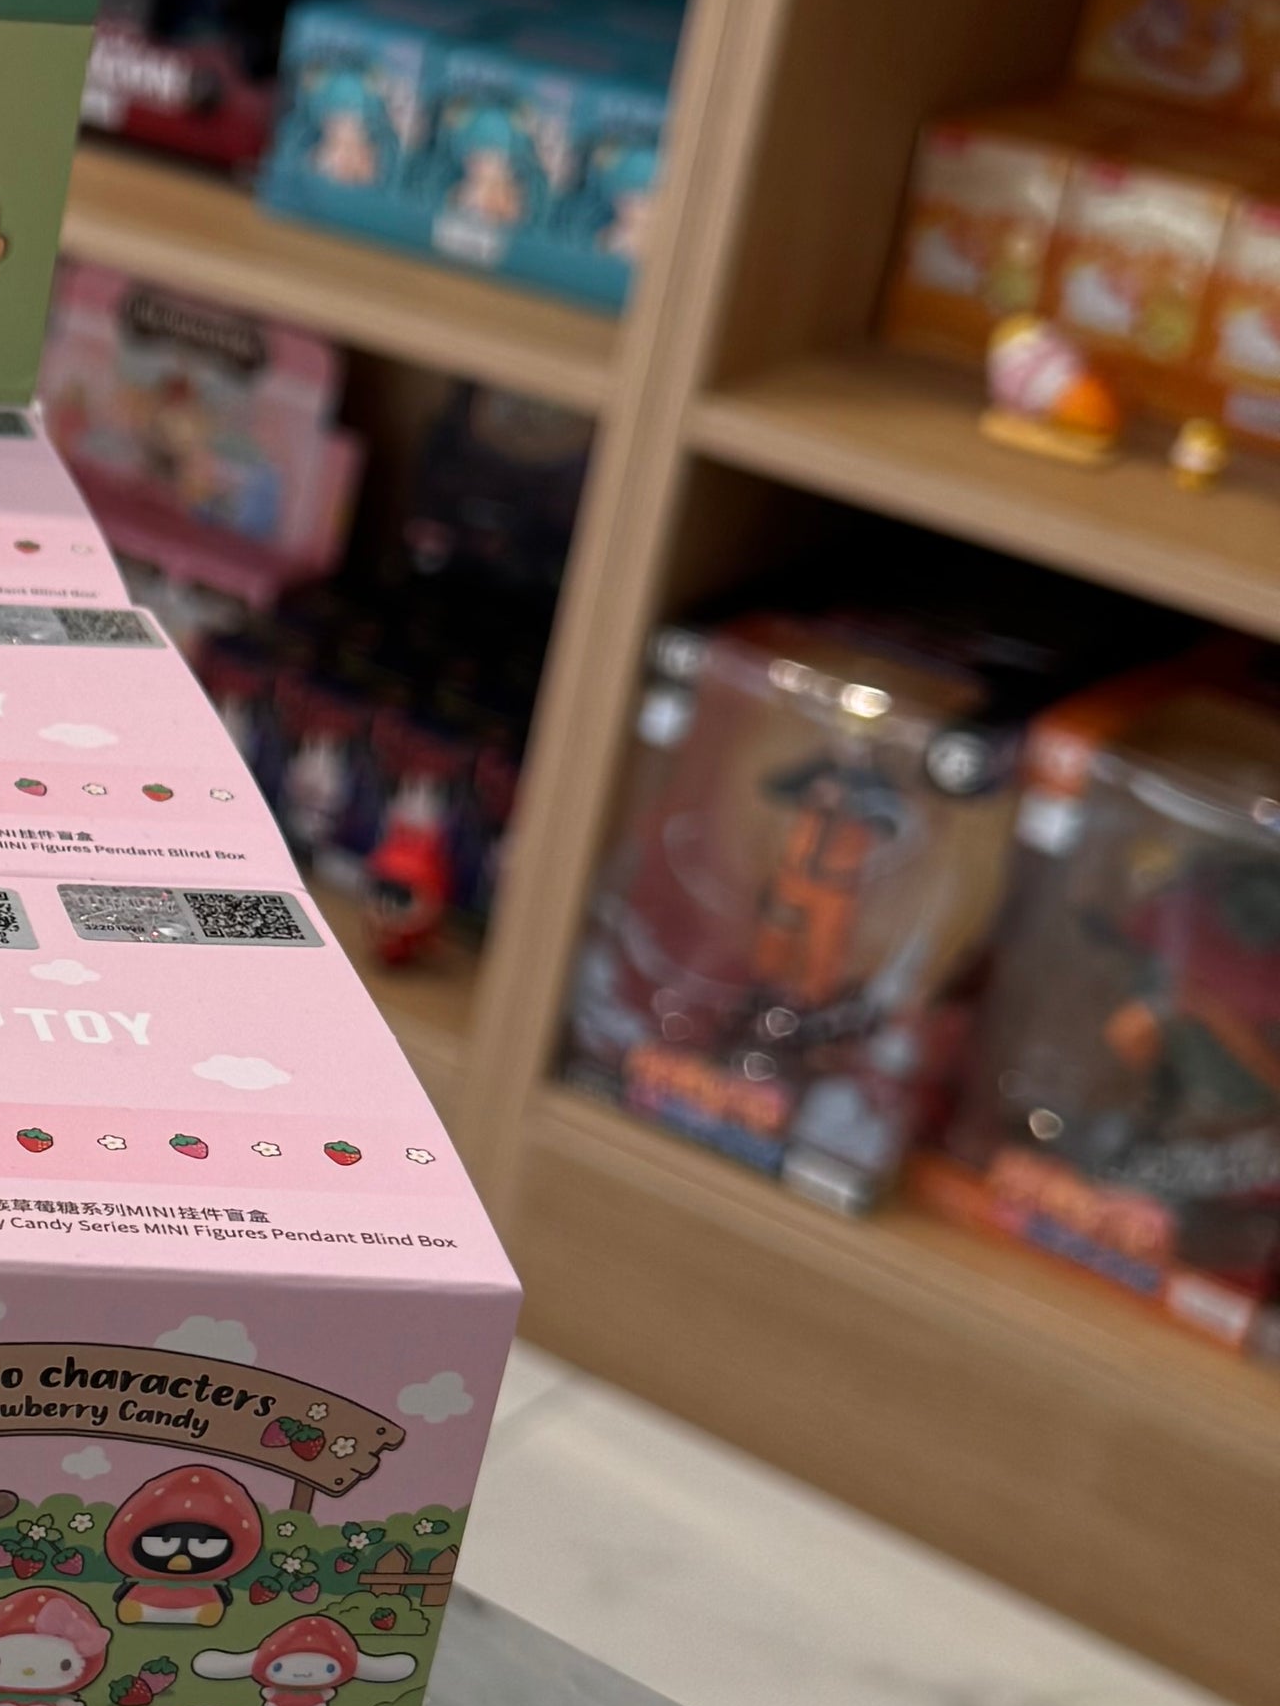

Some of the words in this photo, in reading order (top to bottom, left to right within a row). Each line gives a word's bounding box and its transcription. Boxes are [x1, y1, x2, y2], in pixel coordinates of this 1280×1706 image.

[31, 842, 91, 856] Figures
[94, 845, 164, 857] Pendant
[168, 848, 211, 859] Blind
[215, 850, 246, 860] Box
[15, 1008, 153, 1046] TOY
[10, 1217, 73, 1236] Candy
[78, 1220, 139, 1234] Series
[144, 1223, 189, 1237] MINI
[194, 1225, 267, 1243] Figures
[271, 1228, 357, 1244] Pendant
[360, 1232, 413, 1246] Blind
[418, 1235, 457, 1248] Box
[40, 1357, 277, 1418] characters
[118, 1399, 211, 1439] Candy
